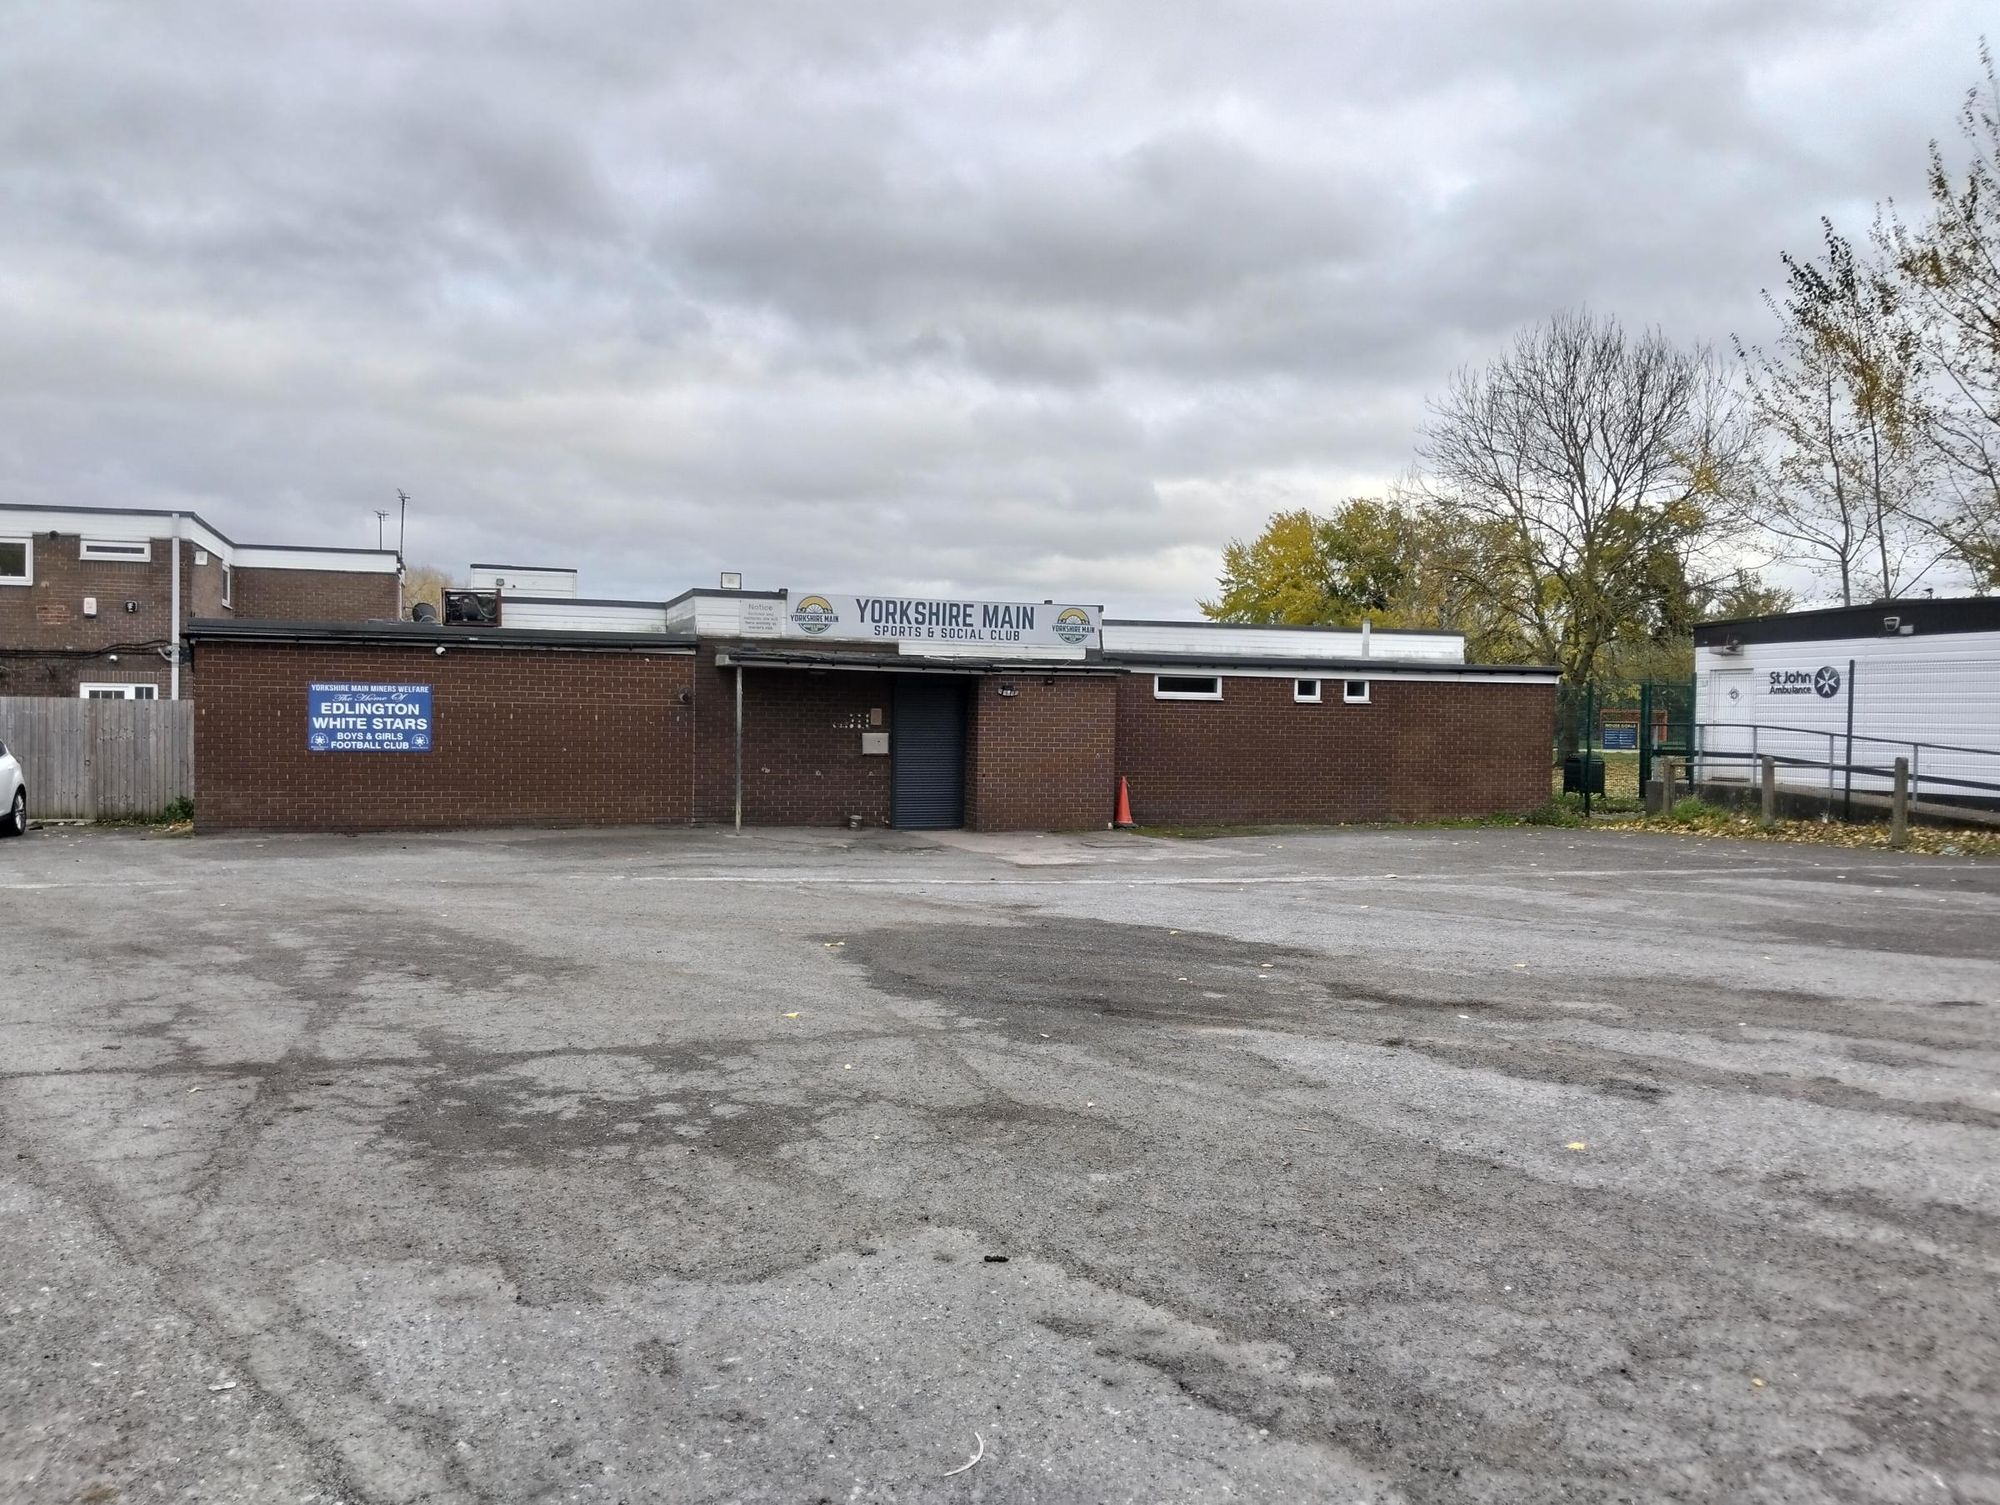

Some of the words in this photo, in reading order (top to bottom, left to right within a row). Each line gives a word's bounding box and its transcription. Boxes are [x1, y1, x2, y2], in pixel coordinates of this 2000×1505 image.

[748, 603, 774, 611] Notice
[790, 614, 823, 623] YORKSHIRE
[824, 615, 839, 623] MAIN
[855, 598, 975, 628] YORKSHIRE
[982, 604, 1035, 630] MAIN
[874, 625, 922, 638] SPORTS
[927, 627, 935, 638] &
[940, 629, 984, 640] SOCIAL
[990, 630, 1020, 641] CLUB
[1052, 625, 1081, 633] YORKSHIRE
[1770, 671, 1781, 684] St
[1783, 670, 1812, 684] John
[311, 684, 349, 692] YORKSHIRE
[371, 685, 397, 693] MINERS
[1769, 686, 1812, 695] Ambulance
[333, 694, 352, 702] The
[355, 693, 387, 702] Home
[391, 692, 408, 703] Of
[320, 702, 420, 715] EDLINGTON
[312, 717, 367, 730] WHITE
[372, 718, 428, 730] STARS
[337, 732, 363, 740] BOYS
[366, 732, 372, 740] &
[331, 741, 381, 749] FOOTBALL
[384, 742, 409, 750] CLUB
